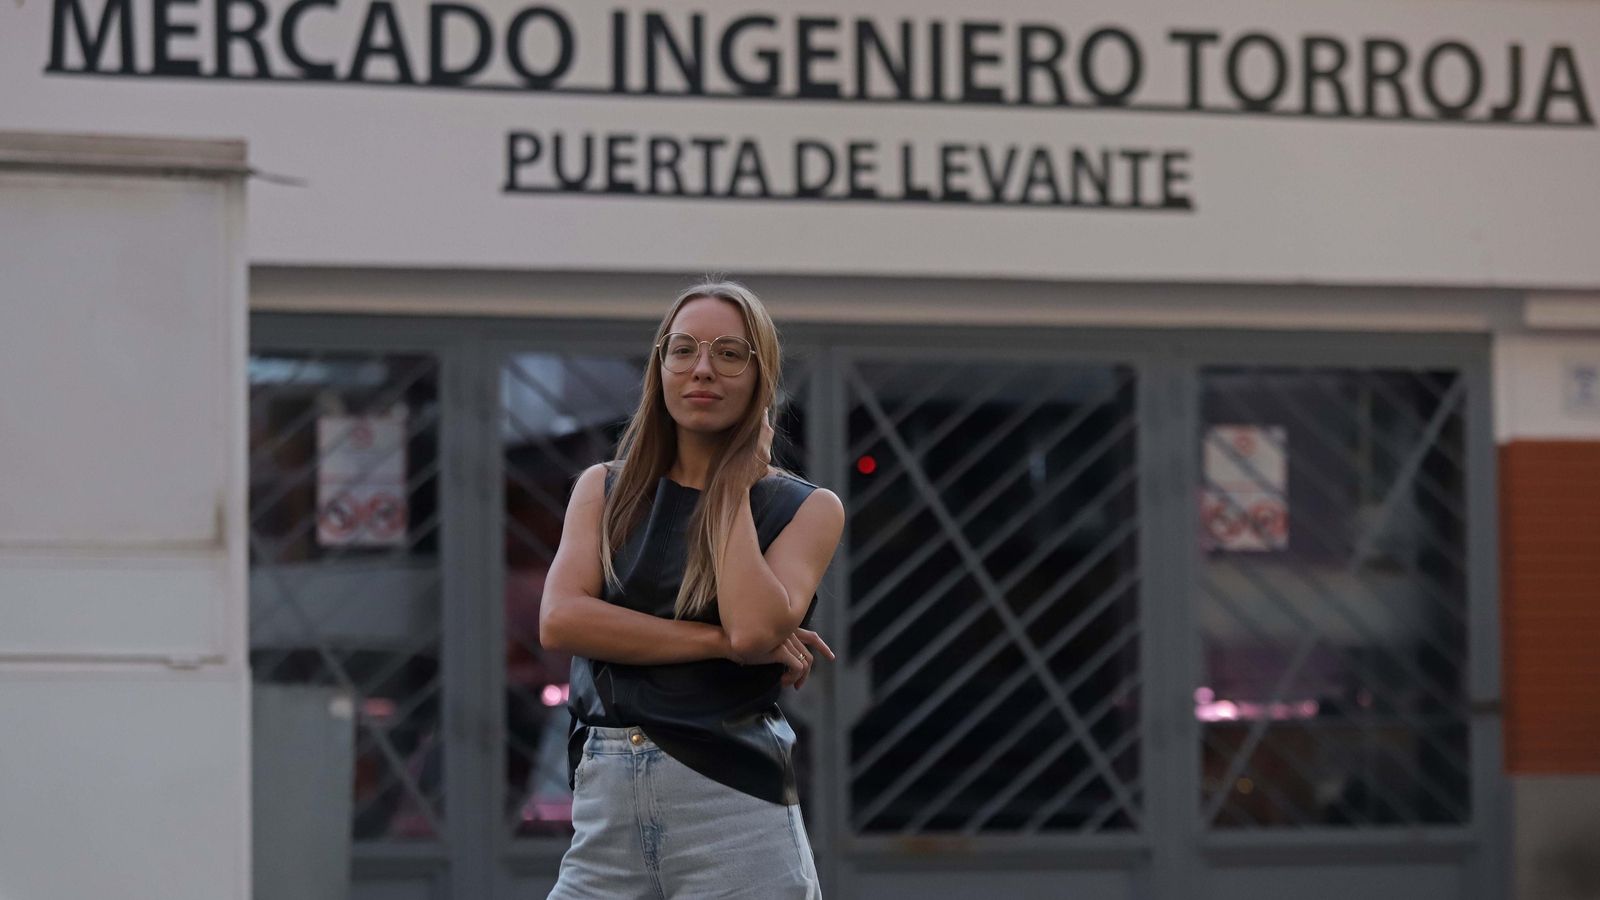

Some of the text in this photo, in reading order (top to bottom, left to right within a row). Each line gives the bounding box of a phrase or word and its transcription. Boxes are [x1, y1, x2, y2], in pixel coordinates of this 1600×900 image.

[48, 0, 1594, 125] MERCADO INGENIERO TORROJA
[505, 130, 1193, 209] PUERTA DE LEVANTE
